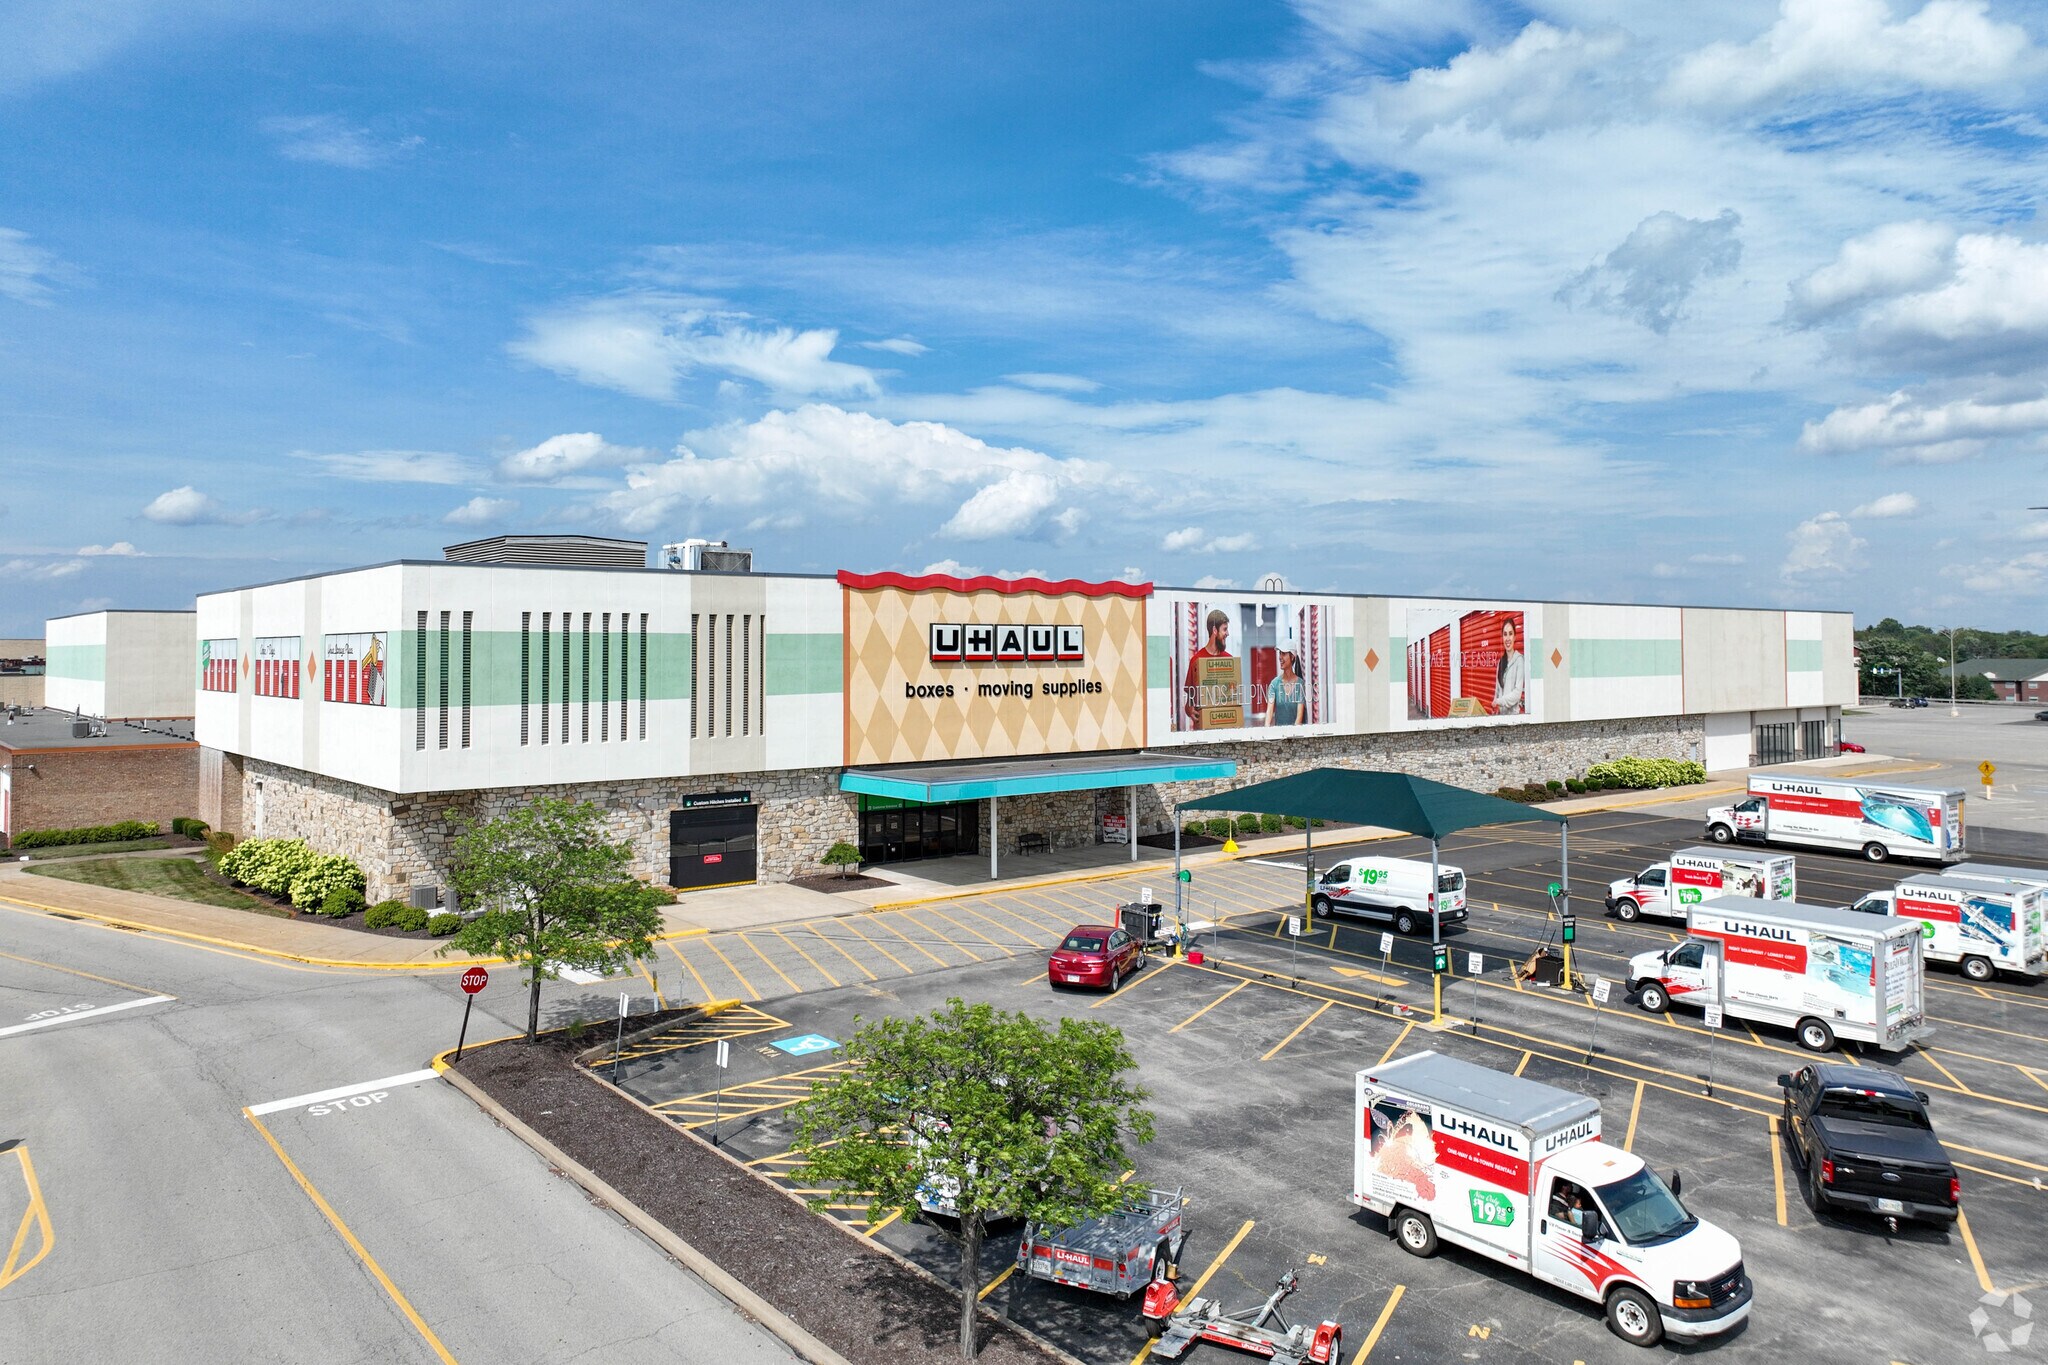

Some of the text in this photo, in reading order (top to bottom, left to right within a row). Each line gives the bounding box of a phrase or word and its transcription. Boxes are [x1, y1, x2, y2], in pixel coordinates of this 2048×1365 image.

[936, 628, 1079, 652] U-HAUL
[905, 678, 1103, 699] boxes moving supplies
[1183, 684, 1228, 707] FRIENDS
[1231, 683, 1276, 705] HELPING
[1772, 783, 1822, 795] U-HAUL
[1676, 858, 1719, 870] U-HAUL
[1902, 888, 1956, 902] U-HAUL
[1724, 921, 1797, 942] U-HAUL
[462, 975, 487, 986] STOP
[307, 1091, 389, 1116] STOP
[1440, 1113, 1519, 1152] U-HAUL
[1546, 1122, 1593, 1152] U-HAUL
[1446, 1147, 1468, 1160] ONE-WAY
[1473, 1156, 1494, 1169] IN-TOWN
[1494, 1163, 1516, 1176] RENTALS
[1056, 1251, 1089, 1265] U-HAUL
[1241, 1342, 1275, 1356] uhaul.com
